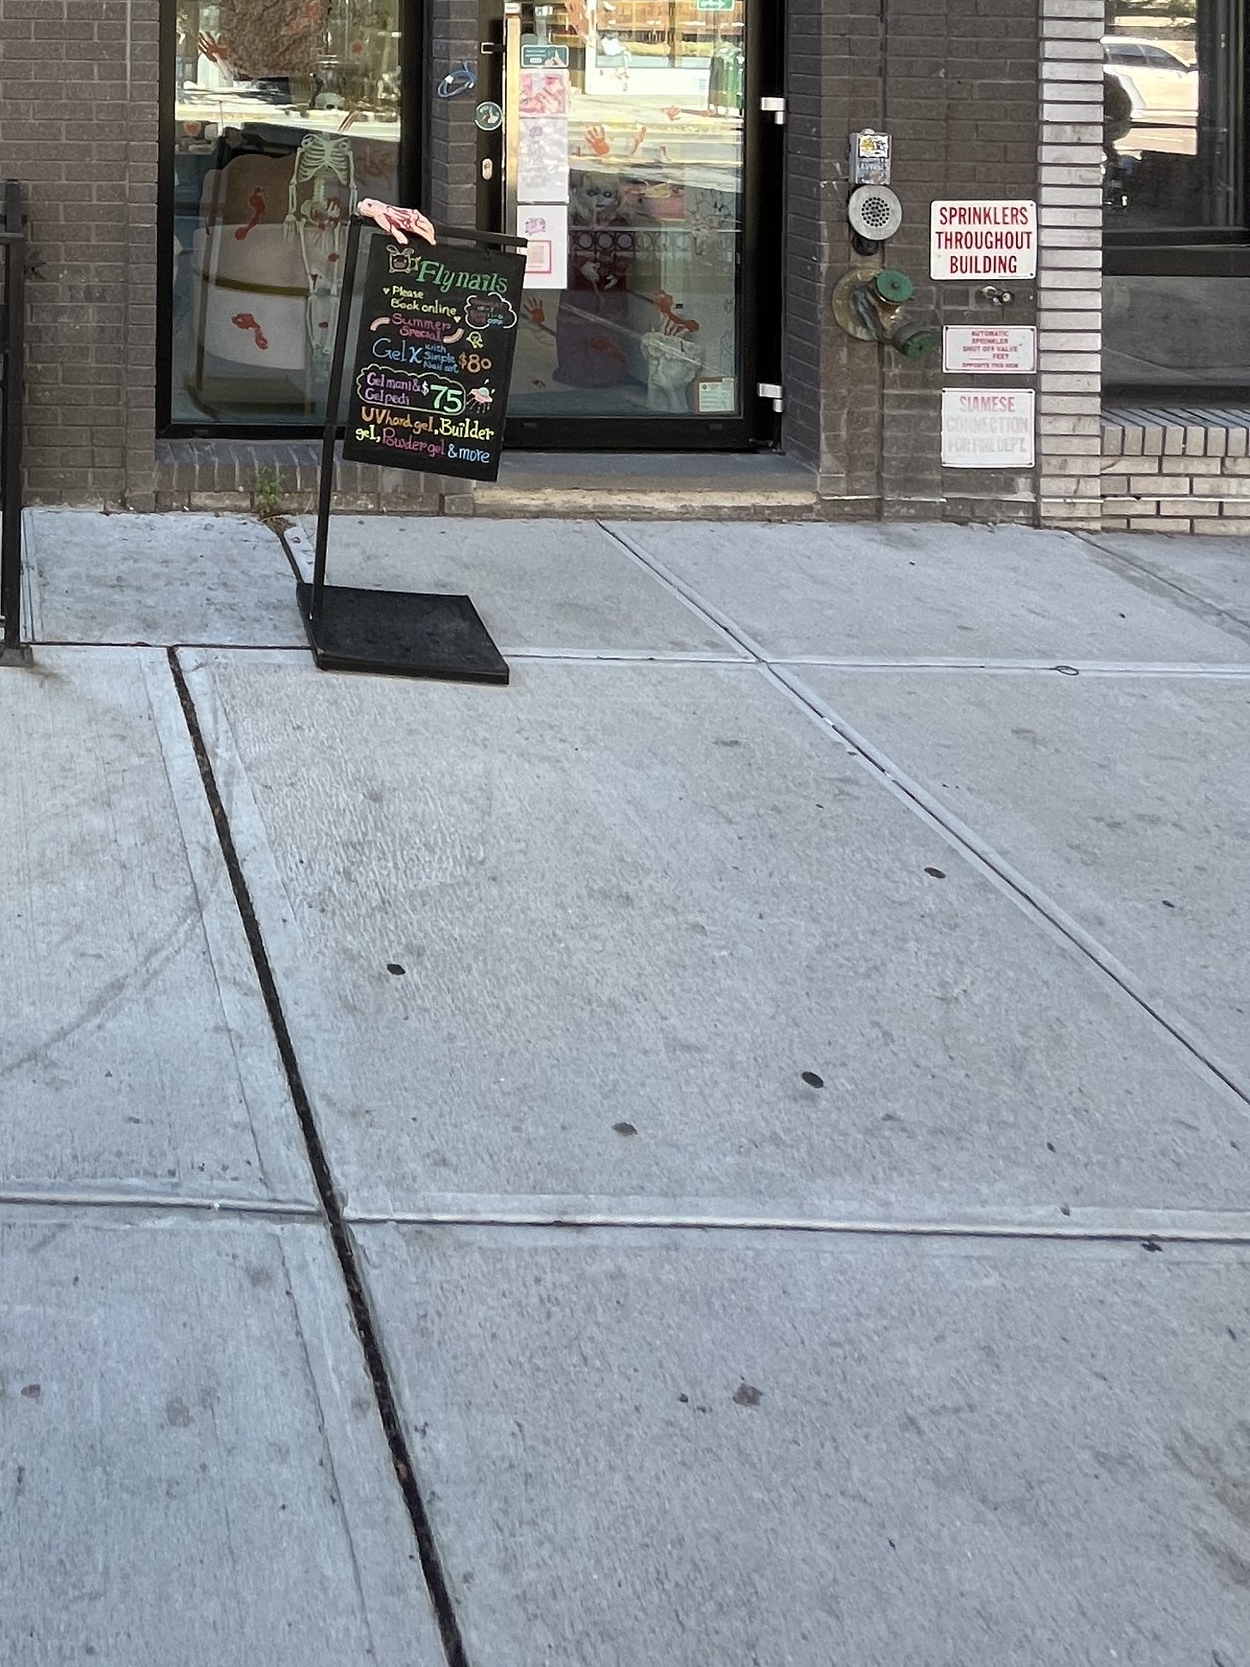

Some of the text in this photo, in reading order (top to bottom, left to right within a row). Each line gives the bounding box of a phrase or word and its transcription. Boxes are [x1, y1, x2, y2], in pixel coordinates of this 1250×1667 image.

[940, 206, 1028, 225] SPRINKLERS
[935, 231, 1033, 249] THROUGHOUT
[950, 255, 1017, 274] BUILDING
[392, 285, 424, 299] Please
[390, 297, 420, 311] Book
[421, 299, 457, 317] online
[391, 313, 452, 330] Summer
[399, 325, 442, 341] Special
[372, 338, 406, 362] Gel
[424, 352, 456, 364] Simple
[459, 351, 492, 373] $80
[366, 372, 384, 387] Gel
[364, 387, 384, 401] Gel
[959, 396, 1015, 413] SIAMESE
[361, 406, 386, 423] UV
[439, 417, 495, 441] Builder
[947, 416, 1028, 433] CONNECTION
[948, 437, 971, 453] FOR
[459, 448, 491, 463] more
